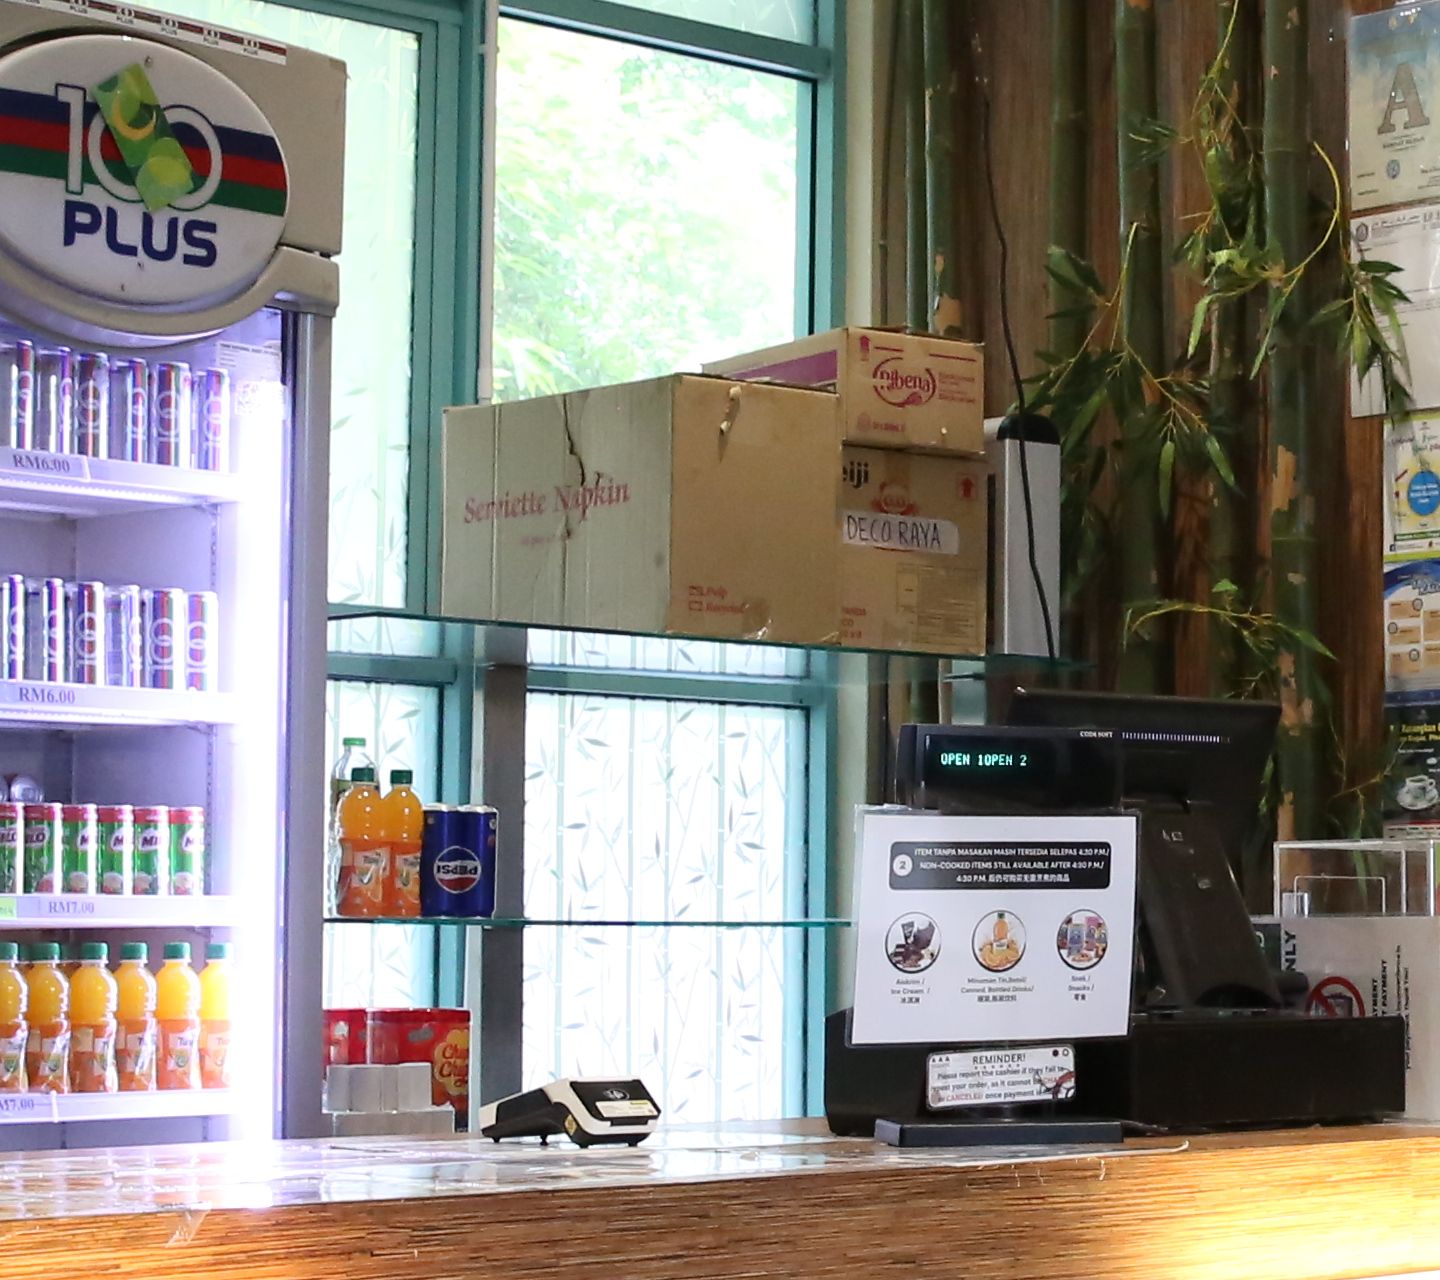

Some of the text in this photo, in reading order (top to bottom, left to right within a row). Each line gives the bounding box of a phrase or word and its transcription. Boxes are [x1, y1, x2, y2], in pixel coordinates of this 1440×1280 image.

[1377, 62, 1430, 135] A
[63, 199, 217, 268] PLUS
[847, 516, 940, 550] DECO RAYA
[19, 687, 75, 704] RM6.00
[941, 752, 970, 766] OPEN
[1020, 755, 1027, 766] 2
[915, 848, 932, 856] ITEM
[934, 848, 956, 856] TANPA
[957, 848, 992, 856] MASAKAN
[973, 1053, 1026, 1065] REMINDER!
